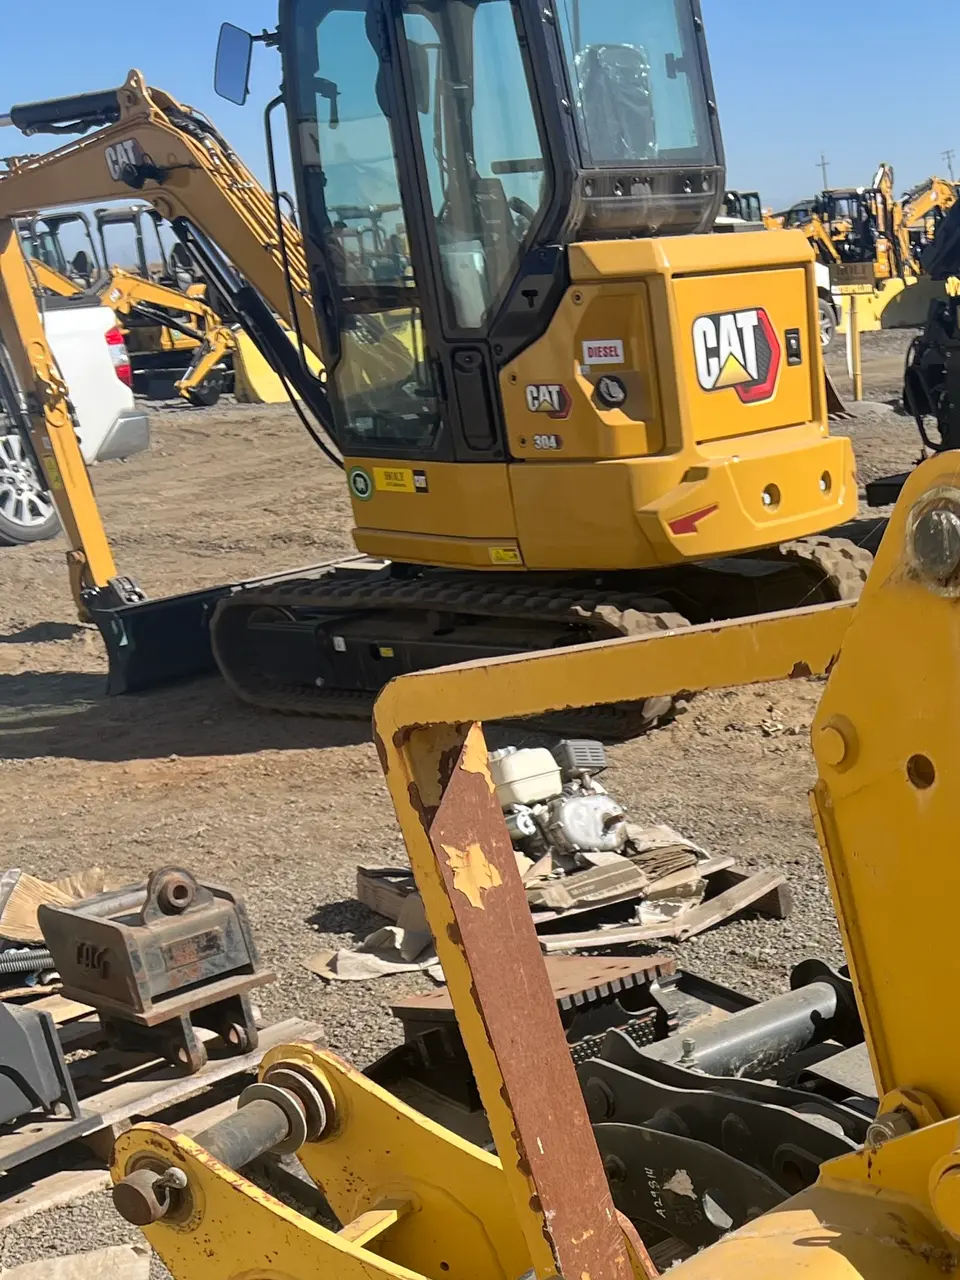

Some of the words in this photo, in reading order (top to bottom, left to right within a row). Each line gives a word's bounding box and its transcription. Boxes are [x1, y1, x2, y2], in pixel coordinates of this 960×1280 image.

[105, 140, 136, 180] CAT
[588, 346, 619, 358] DIESEL
[693, 310, 758, 388] CAT
[526, 385, 560, 411] CAT
[534, 435, 556, 449] 304
